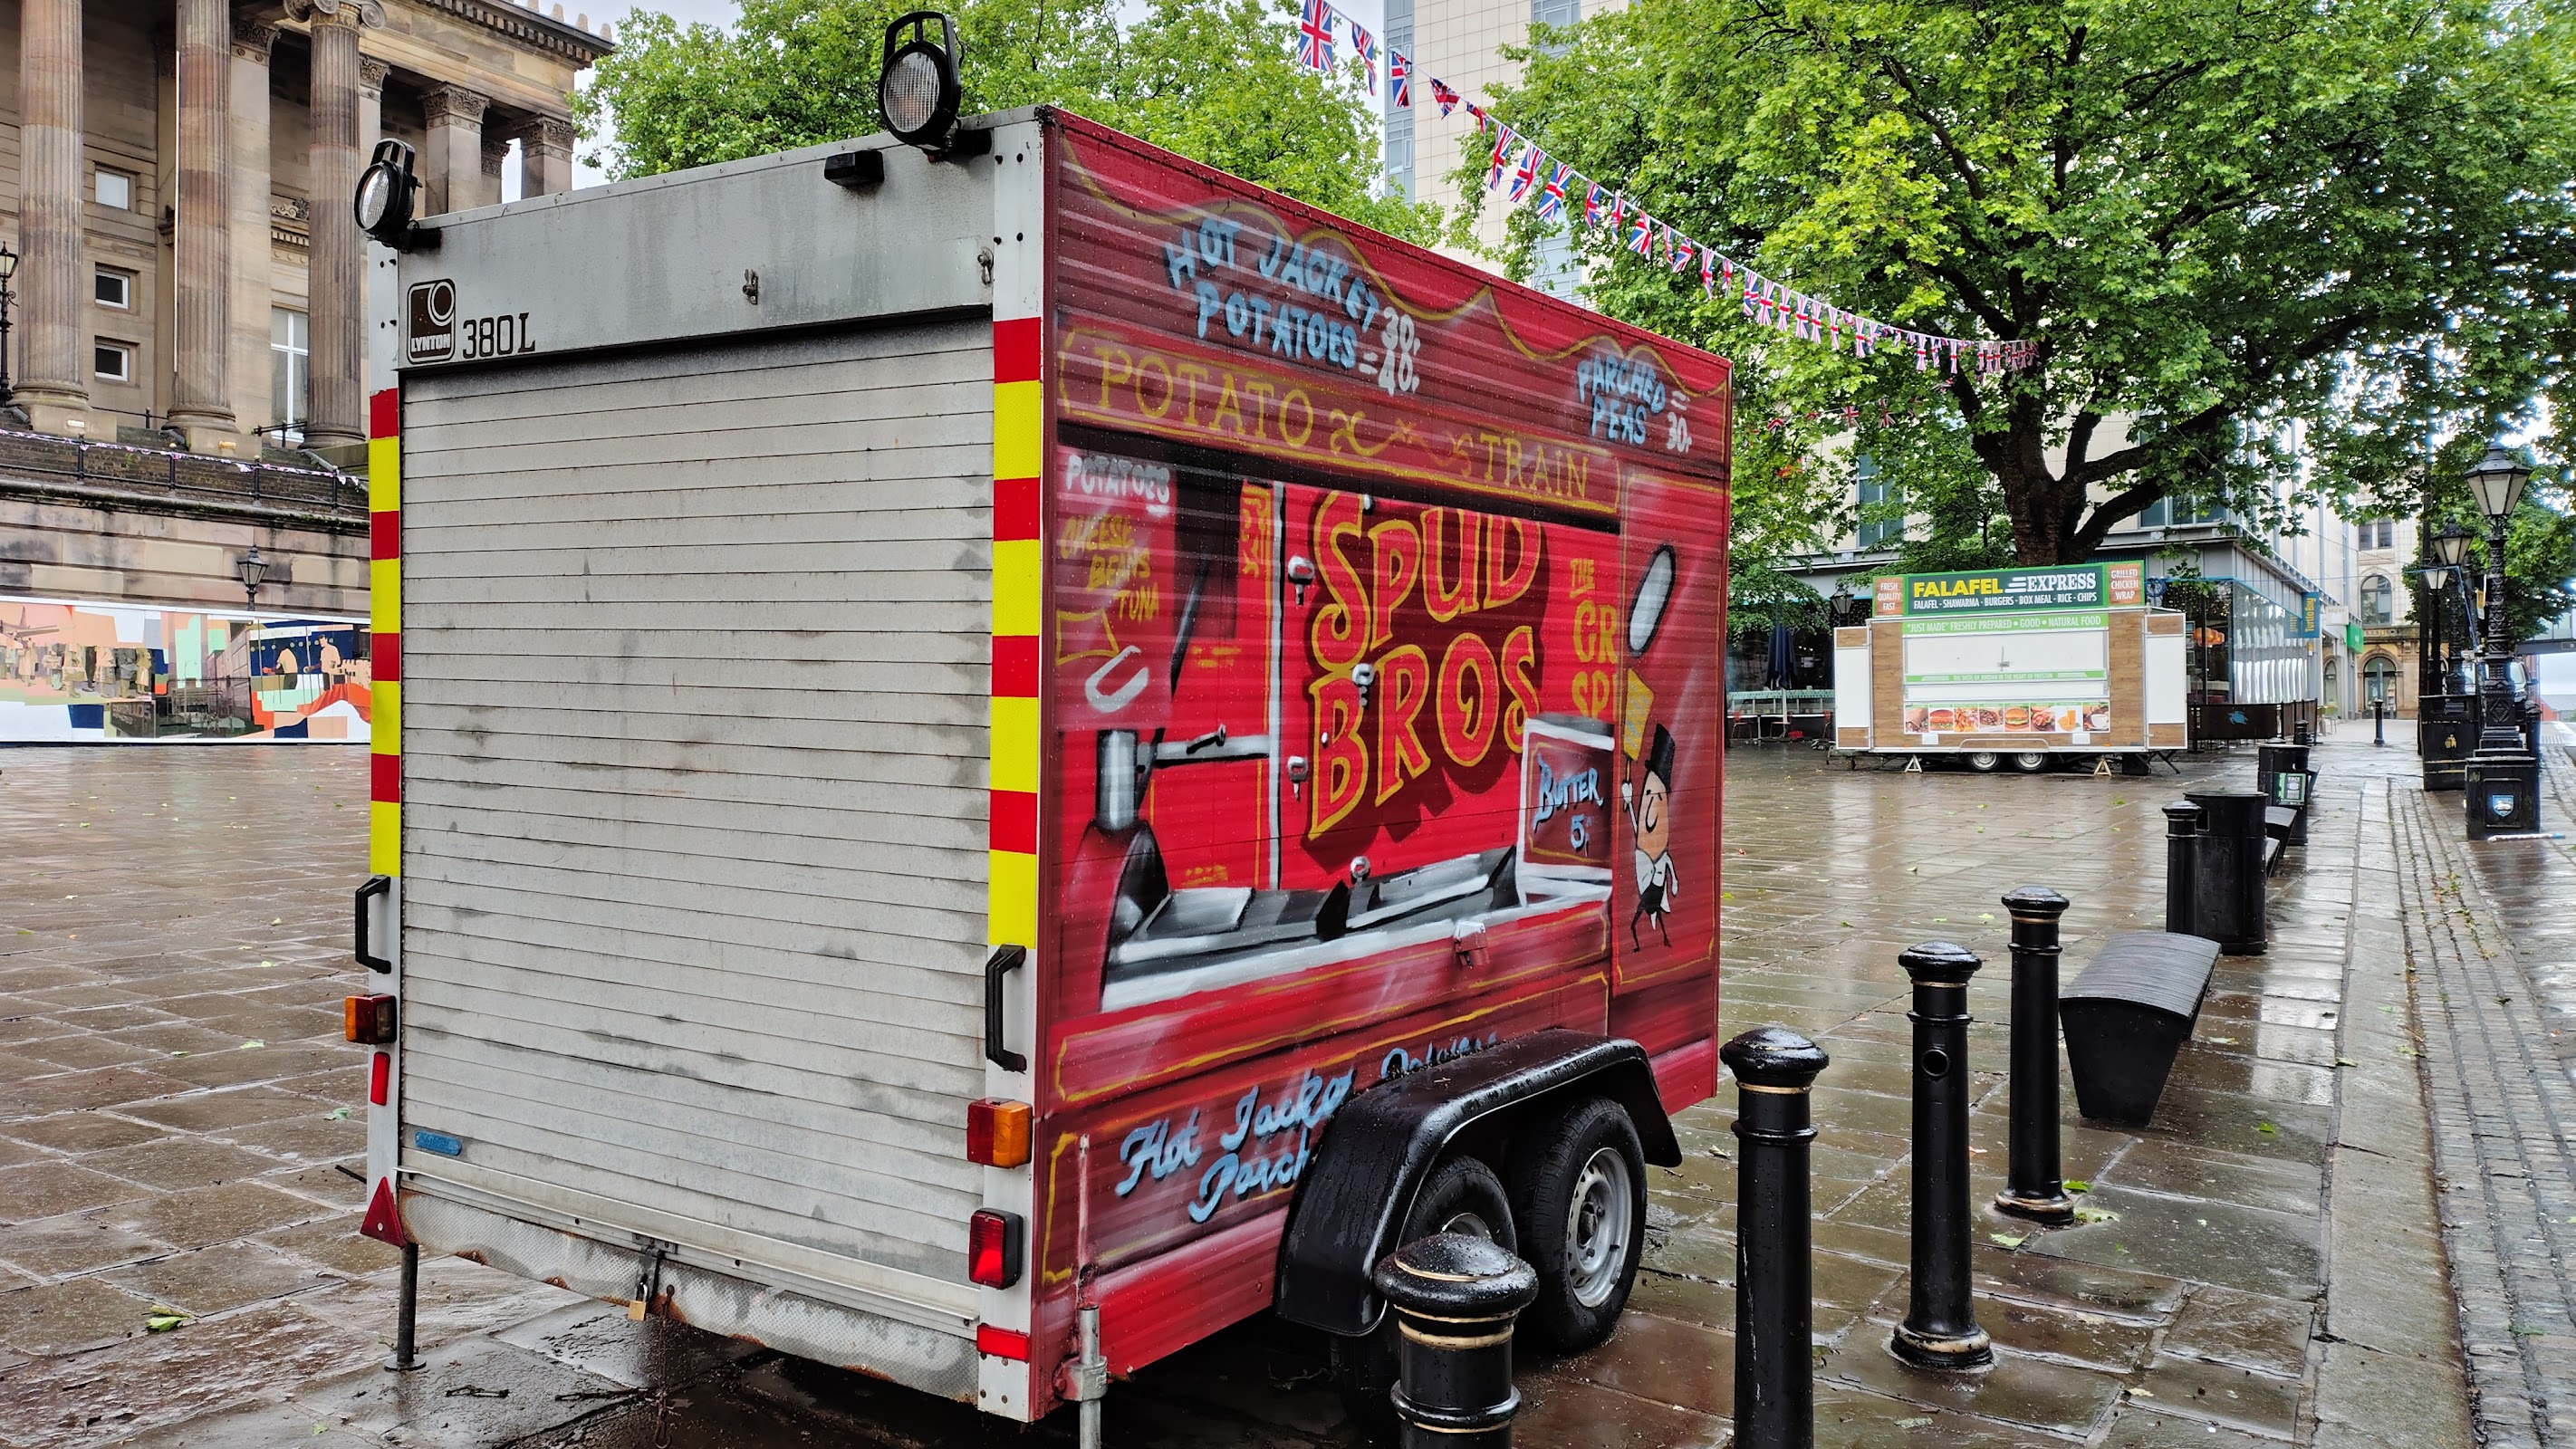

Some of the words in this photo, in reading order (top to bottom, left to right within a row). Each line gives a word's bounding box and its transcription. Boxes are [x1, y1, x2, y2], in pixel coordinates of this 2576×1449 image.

[1164, 217, 1241, 289] HOT
[1259, 235, 1379, 333] JACKET
[411, 333, 451, 353] LYNTON
[1196, 281, 1356, 369] POTATOES
[1577, 353, 1666, 414] PARCHED
[1097, 345, 1314, 448] POTATO
[1479, 433, 1591, 497] TRAIN
[1591, 394, 1647, 445] PEAS
[1066, 454, 1169, 504] POTATOES
[1061, 513, 1134, 559] CHEESE
[1087, 548, 1150, 591] BEANS
[1311, 489, 1541, 672] SPUD
[1570, 558, 1596, 591] THE
[1880, 582, 1898, 590] FRESH
[1914, 578, 2003, 598] FALAFEL
[2027, 572, 2097, 592] EXPRESS
[2110, 569, 2138, 579] GRILLED
[2110, 580, 2139, 589] CHICKEN
[1113, 582, 1159, 622] TUNA
[1878, 592, 1901, 601] QUALITY
[1914, 600, 1939, 609] FALAFEL
[1943, 598, 1979, 608] SHAWARMA
[1985, 596, 2014, 607] BURGERS
[2019, 595, 2033, 605] BOX
[2034, 594, 2052, 604] MEAL
[2058, 593, 2072, 603] RICE
[2077, 592, 2097, 602] CHIPS
[2115, 590, 2135, 600] WRAP
[1950, 619, 1977, 631] FRESHLY
[1978, 619, 2012, 630] PREPARED
[2019, 618, 2041, 629] GOOD
[2049, 617, 2080, 627] NATURAL
[2081, 616, 2101, 627] FOOD
[1308, 625, 1541, 842] BROS
[1533, 753, 1604, 830] BUTTER
[1115, 1107, 1203, 1196] Hot
